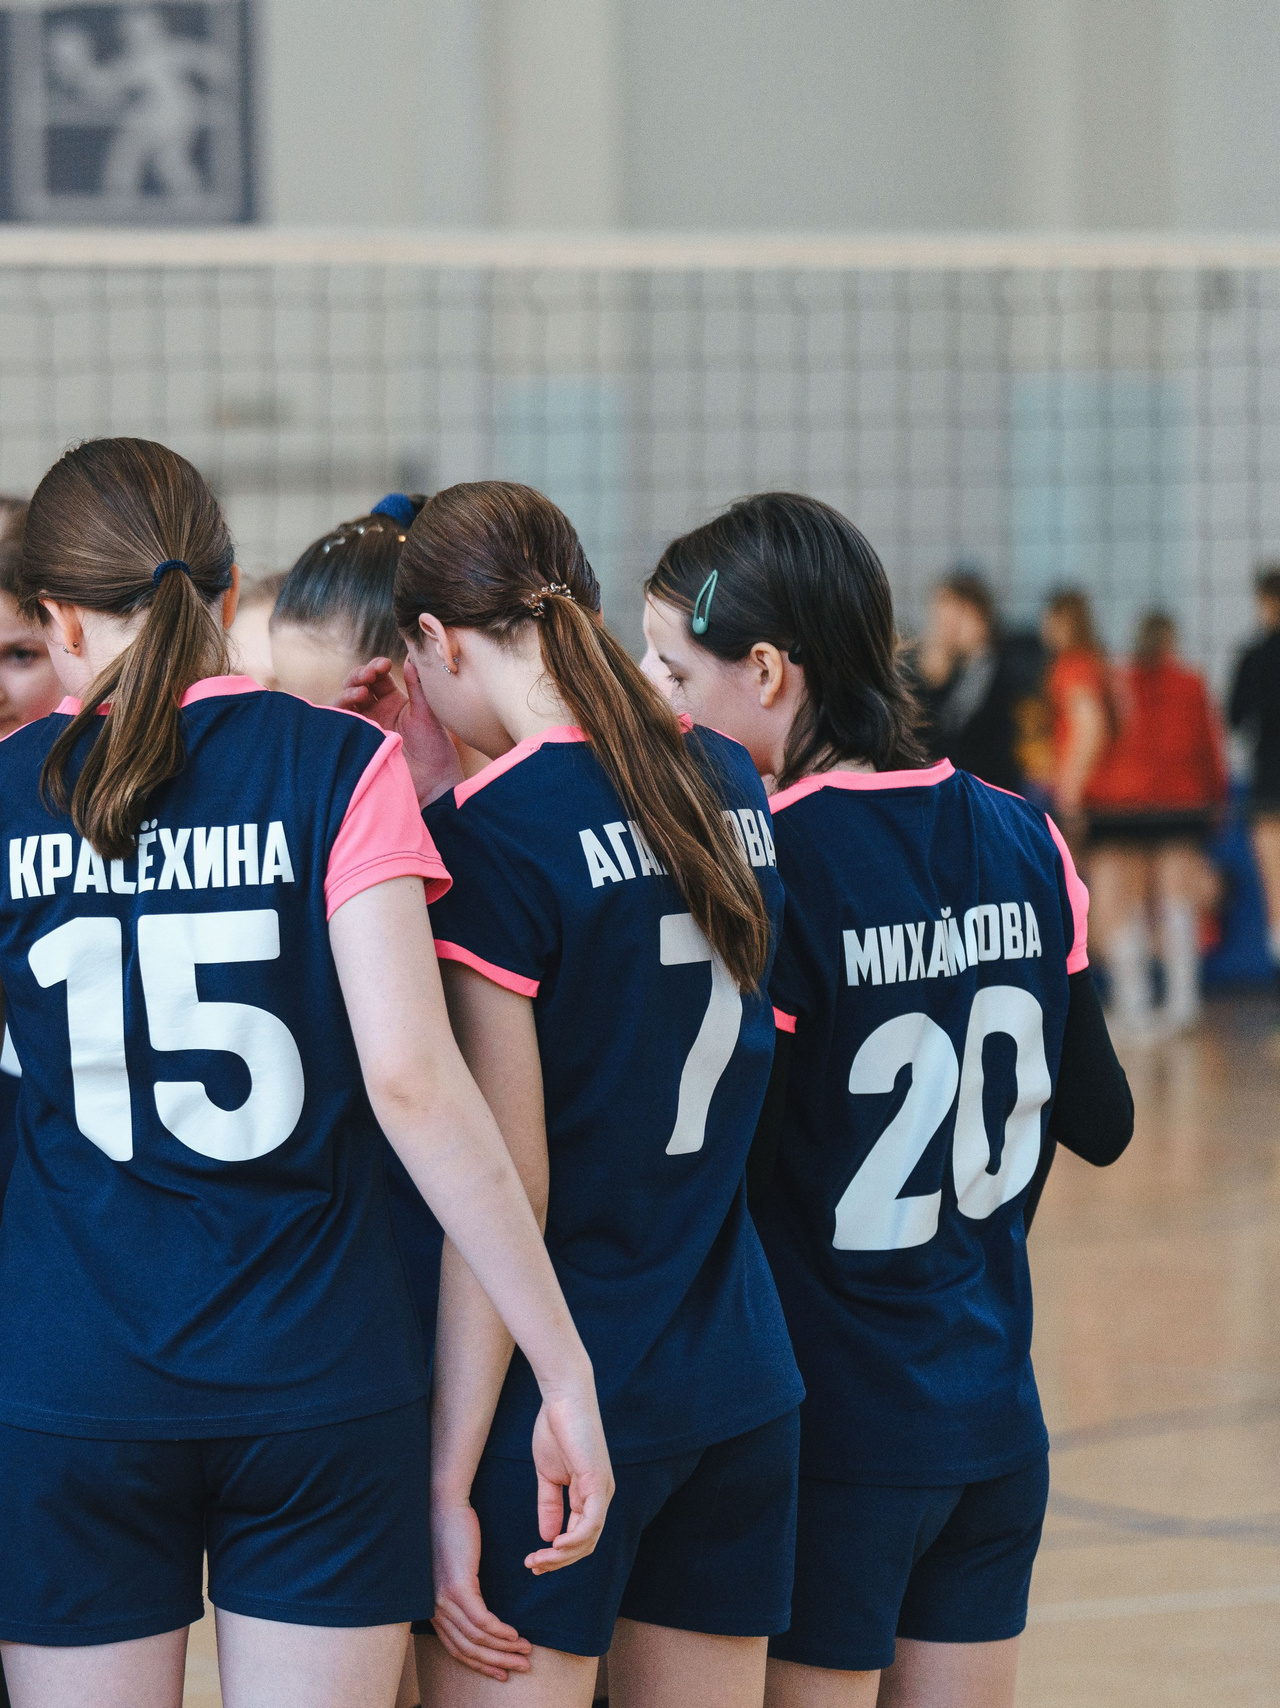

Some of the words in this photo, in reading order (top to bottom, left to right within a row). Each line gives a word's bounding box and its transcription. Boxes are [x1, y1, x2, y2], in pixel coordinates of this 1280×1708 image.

[27, 908, 305, 1162] 15
[659, 912, 744, 1156] 7
[832, 984, 1052, 1251] 20
